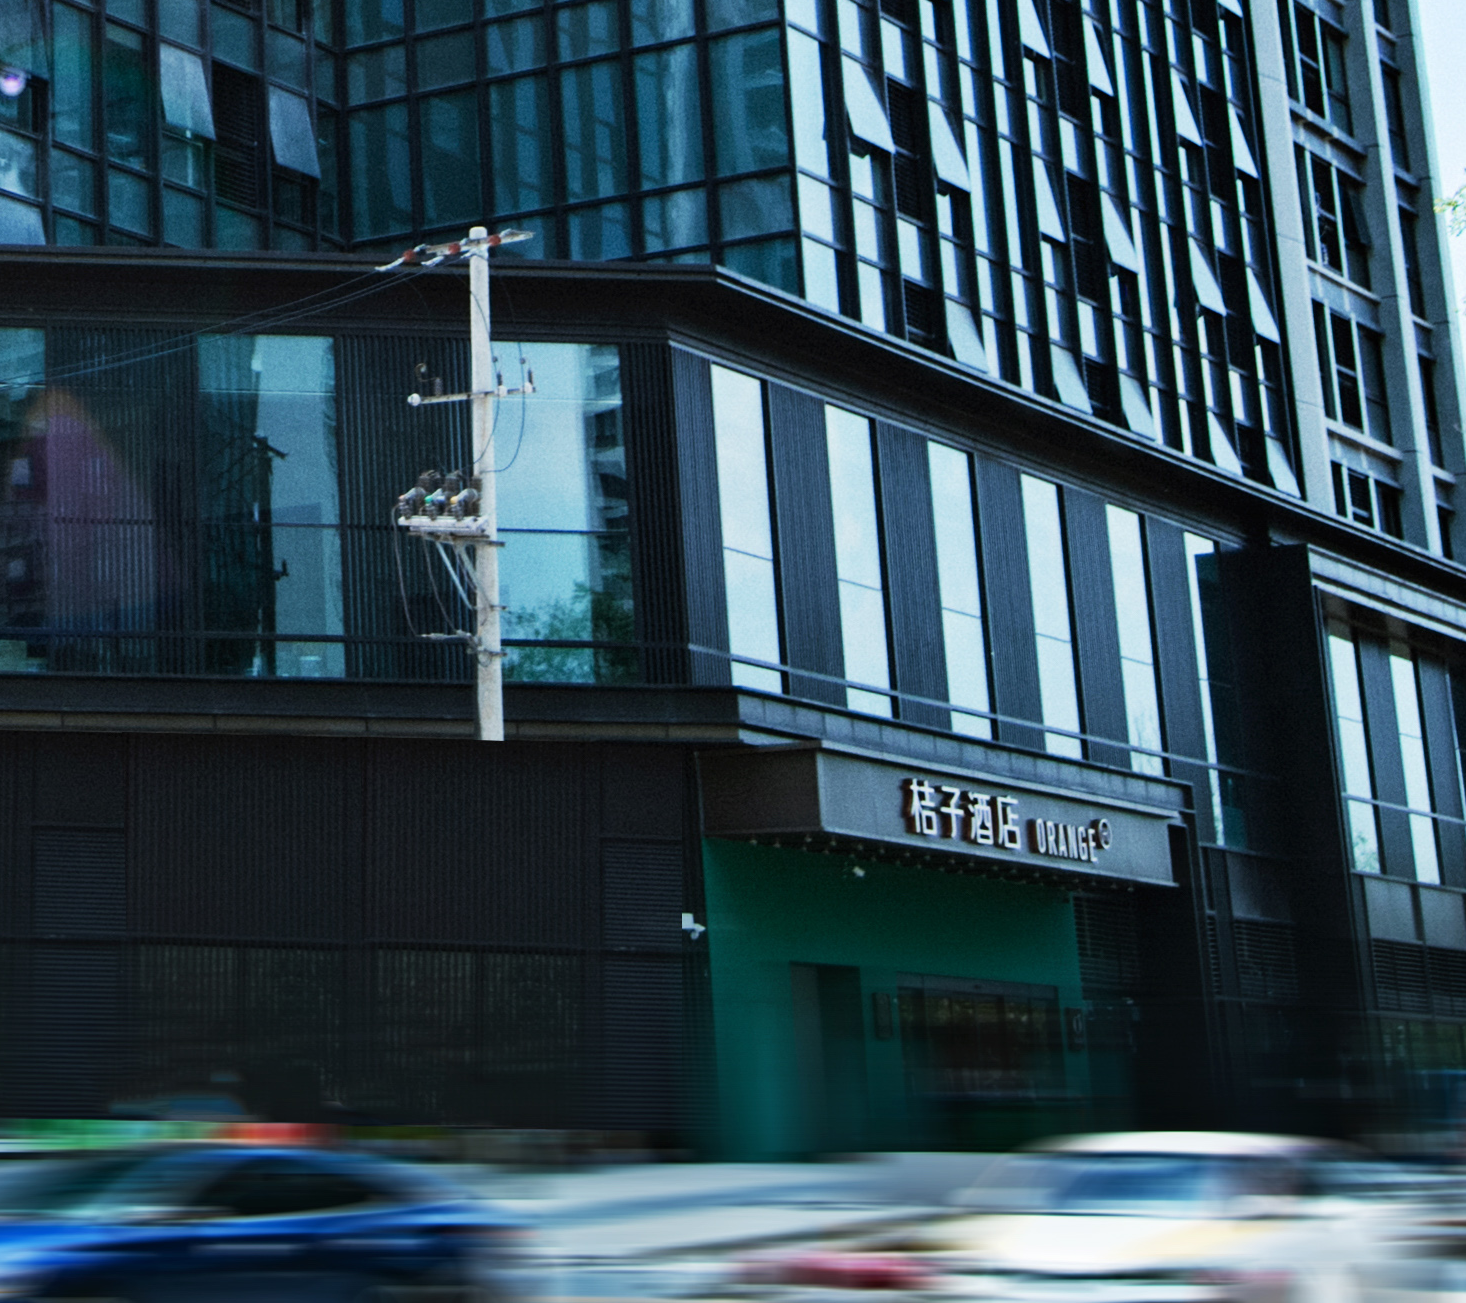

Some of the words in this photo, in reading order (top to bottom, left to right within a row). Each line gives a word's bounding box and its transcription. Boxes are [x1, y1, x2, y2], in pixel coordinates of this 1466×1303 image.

[906, 778, 1022, 850] 桔子酒店
[1033, 817, 1098, 863] ORANGE
